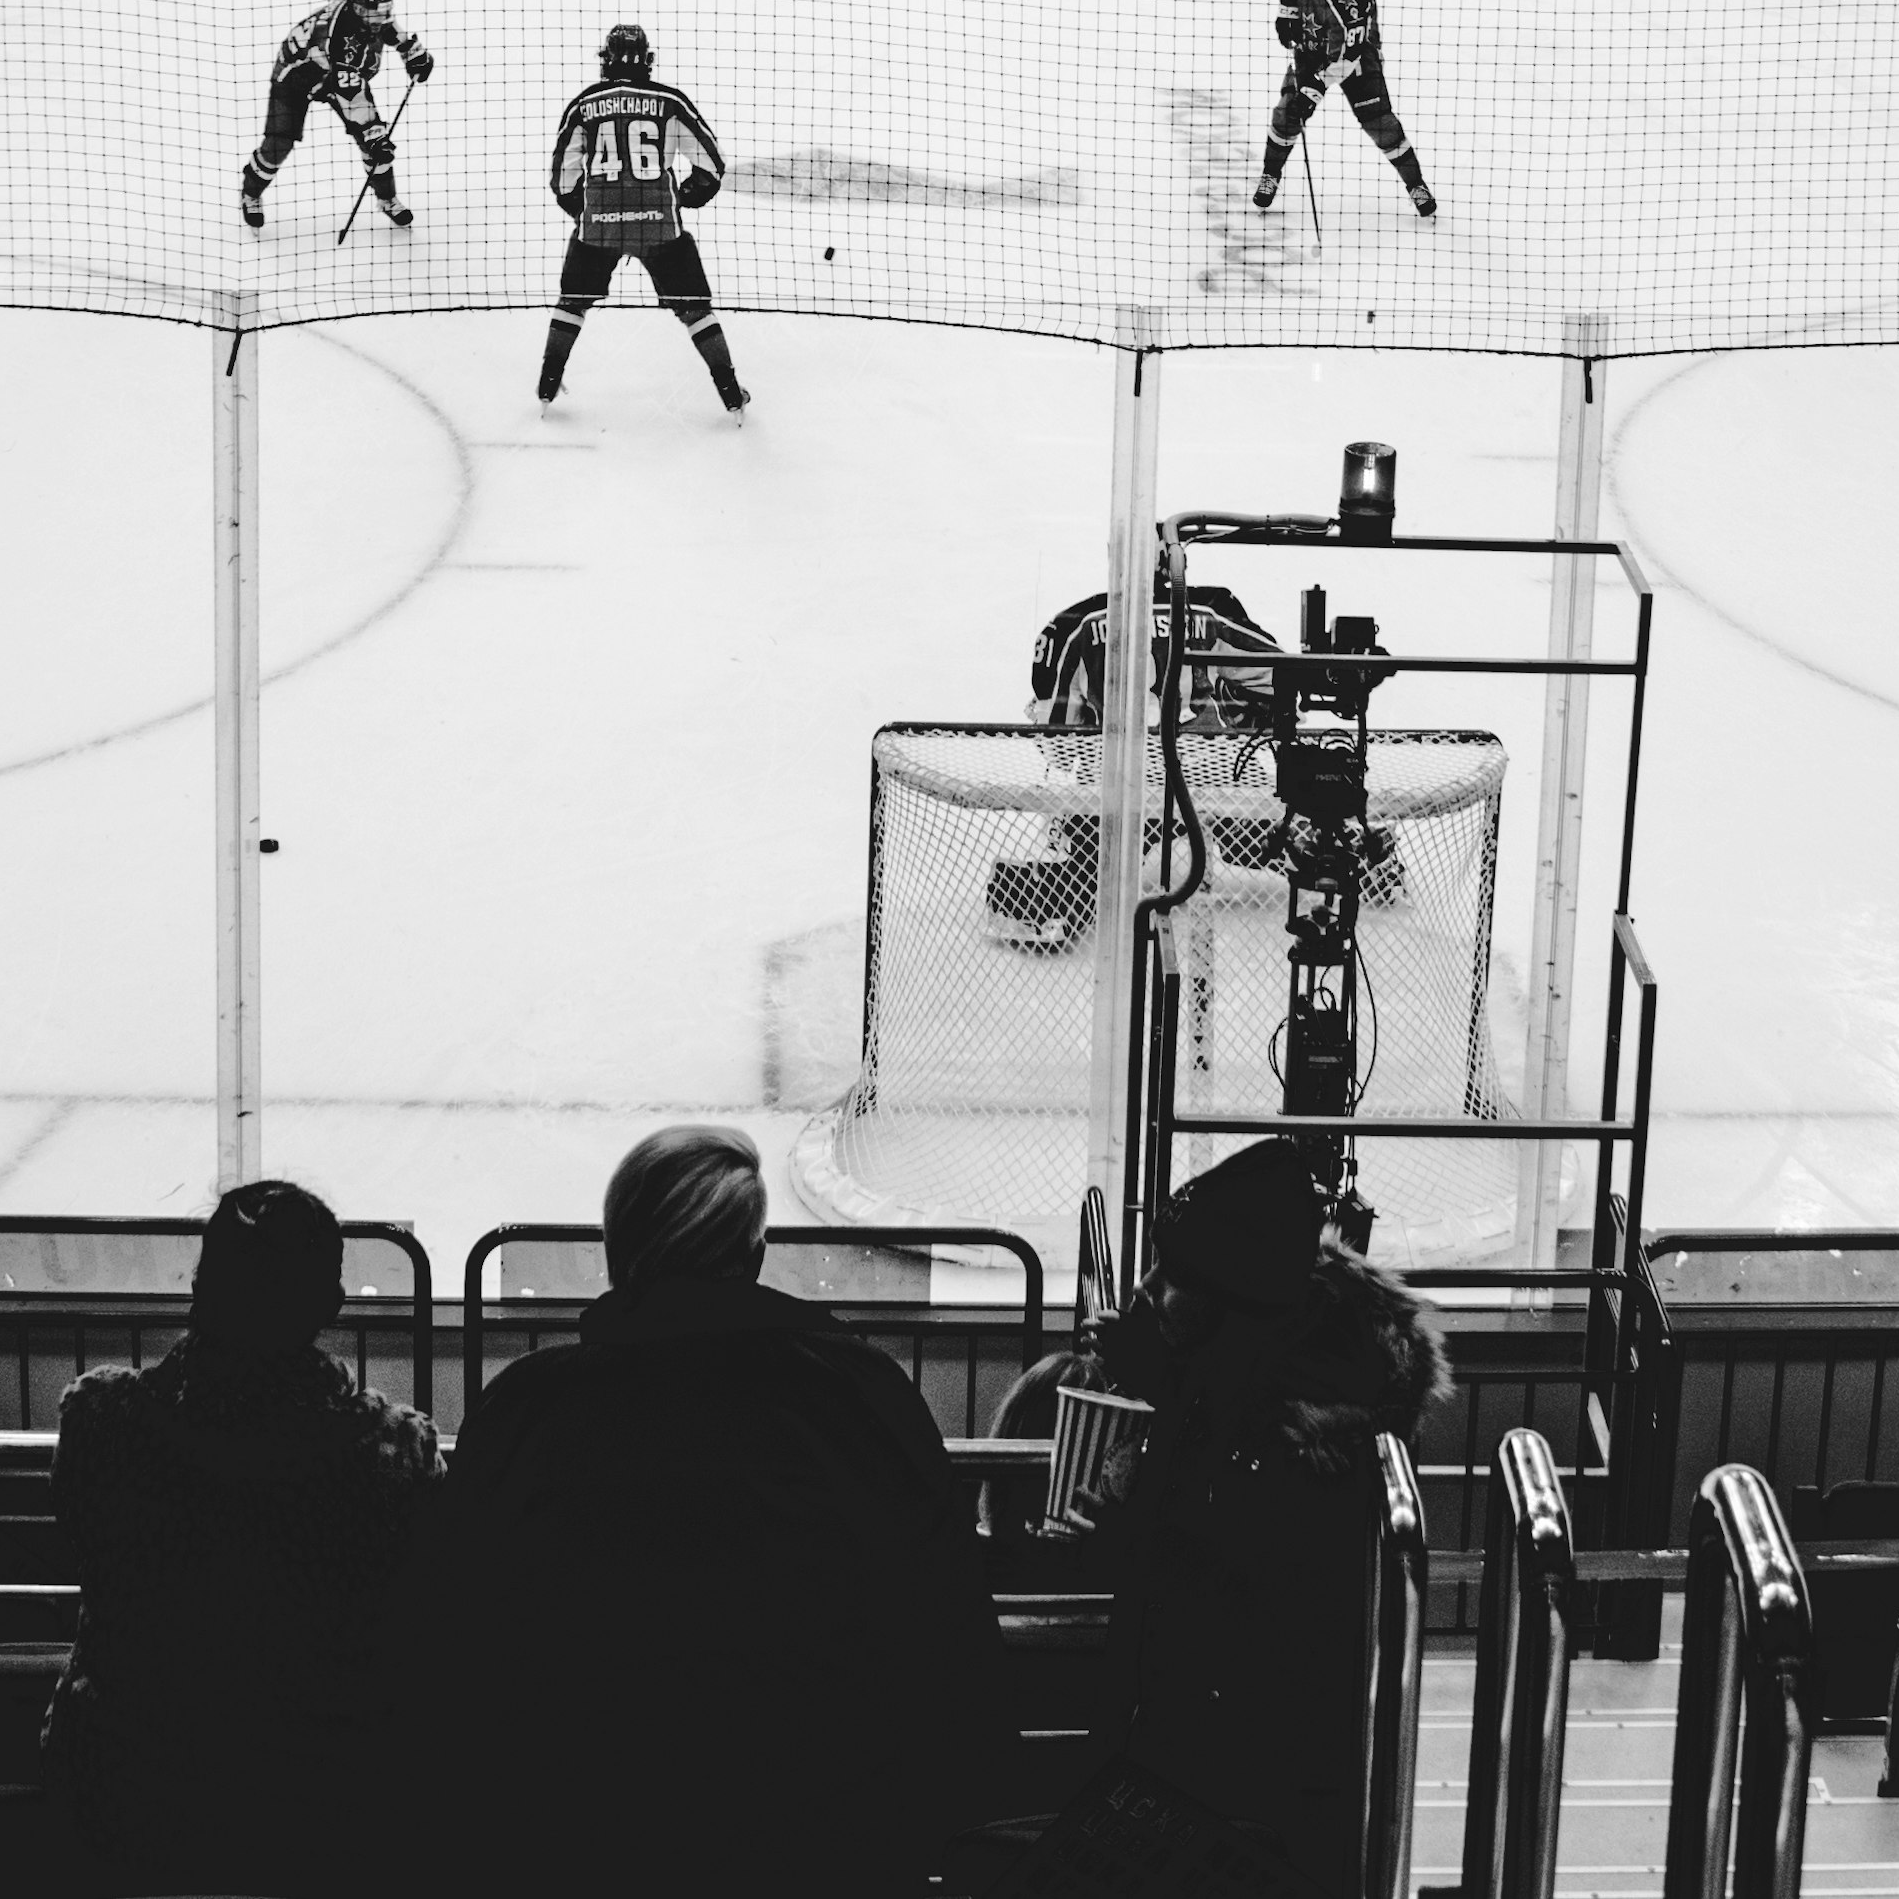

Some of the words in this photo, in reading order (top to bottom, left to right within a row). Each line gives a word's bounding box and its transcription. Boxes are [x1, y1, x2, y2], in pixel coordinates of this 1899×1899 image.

[337, 70, 360, 88] 22
[590, 119, 662, 181] 46
[591, 210, 664, 224] РОСНЕФТЬ
